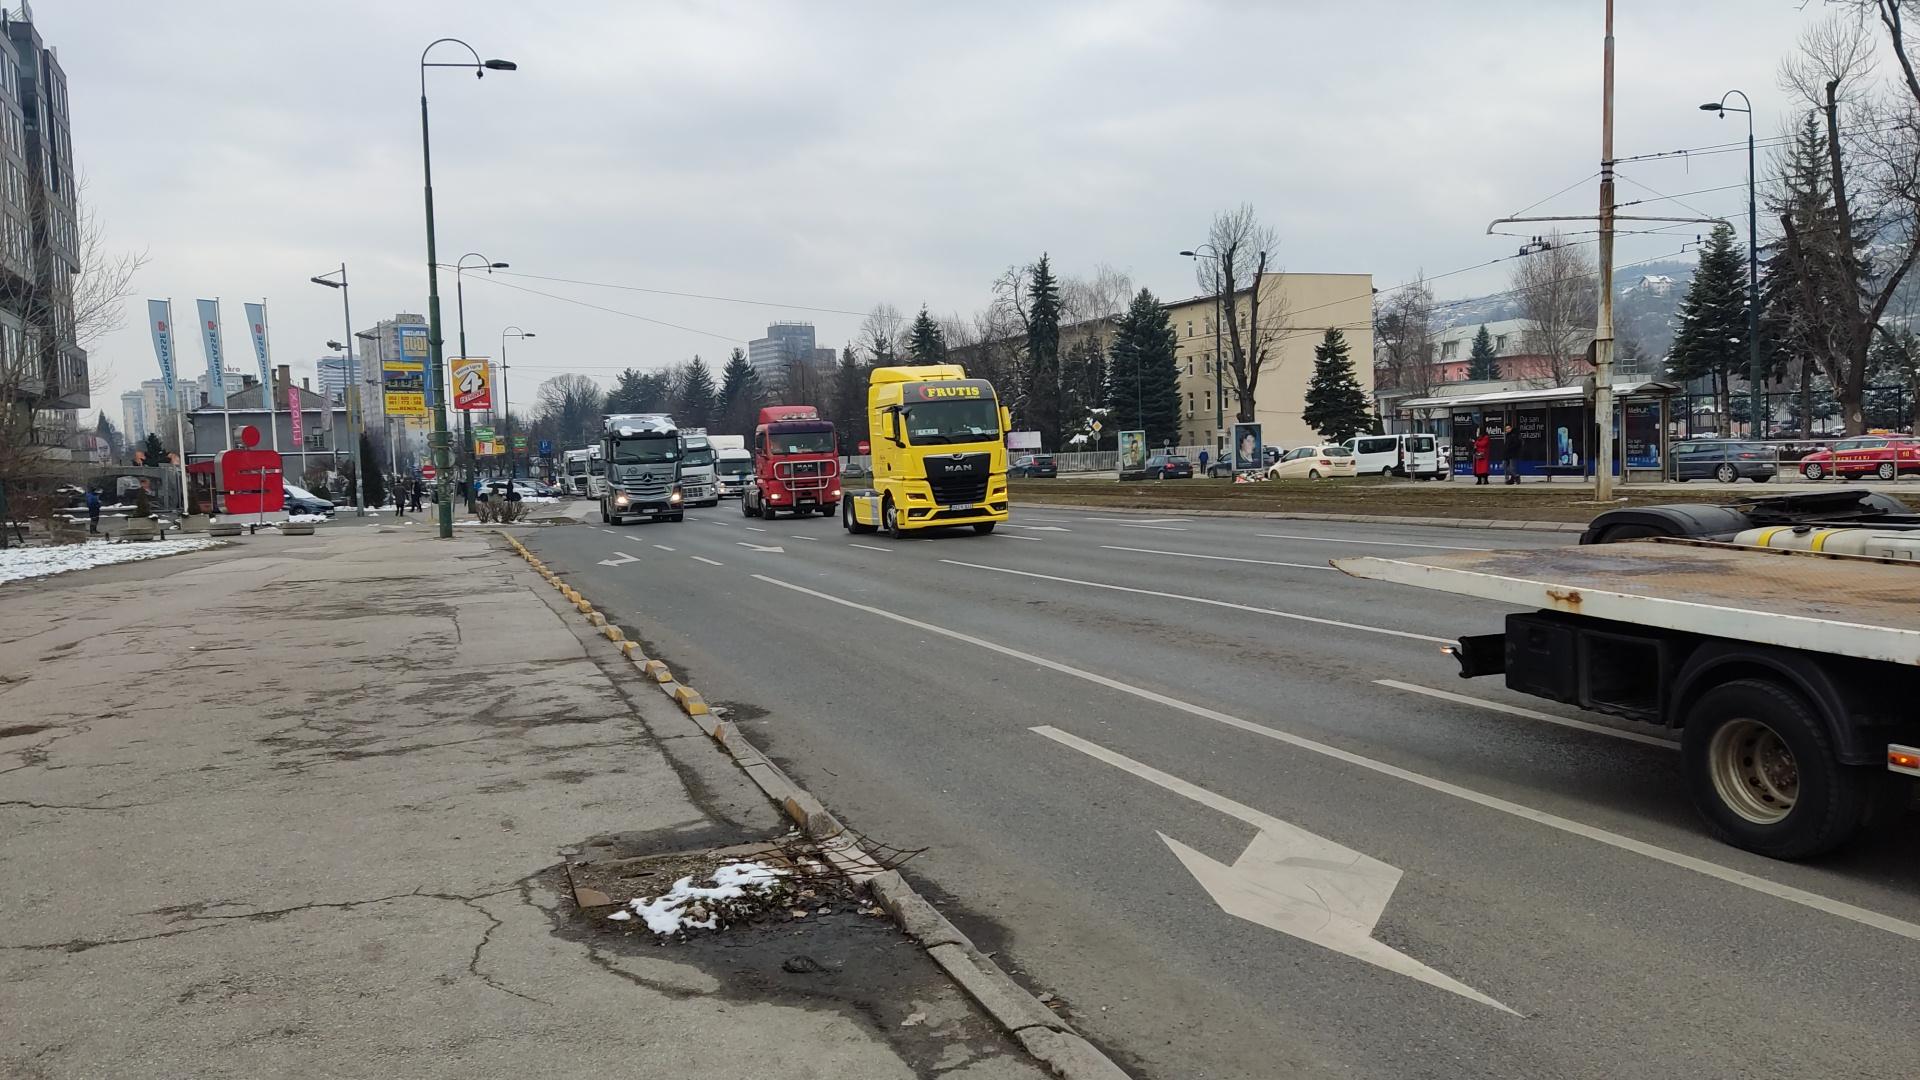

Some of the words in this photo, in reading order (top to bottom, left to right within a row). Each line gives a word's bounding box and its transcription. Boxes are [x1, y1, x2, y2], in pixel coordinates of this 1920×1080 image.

[459, 370, 485, 394] 4
[927, 386, 980, 398] FRUTIS
[944, 464, 972, 472] MAN
